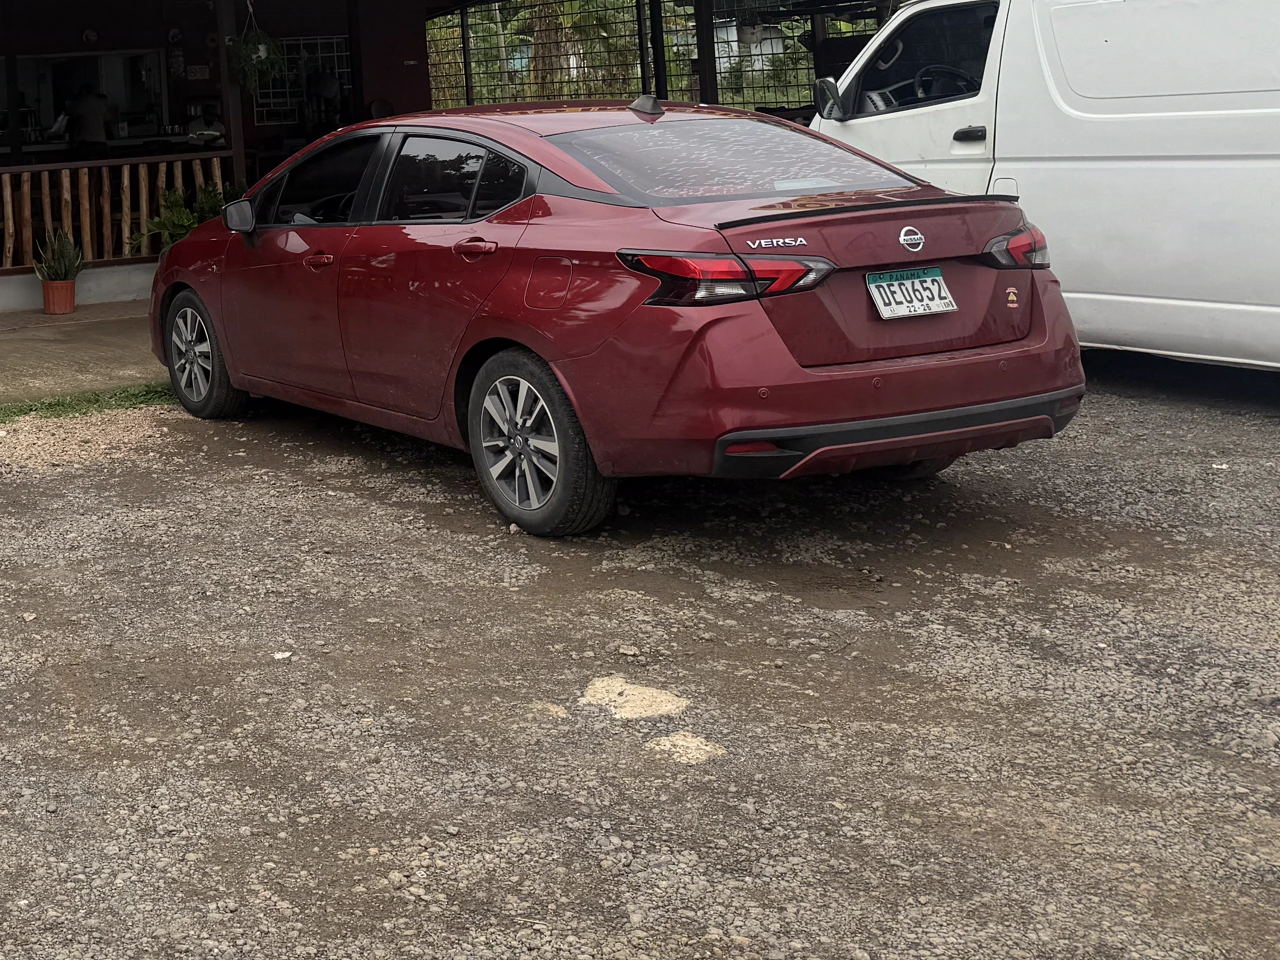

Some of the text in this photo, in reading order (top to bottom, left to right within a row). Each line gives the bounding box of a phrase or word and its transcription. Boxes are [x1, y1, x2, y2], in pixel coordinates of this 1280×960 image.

[746, 237, 808, 249] VERSA
[889, 271, 920, 282] PANAMA
[874, 278, 948, 307] DE0652
